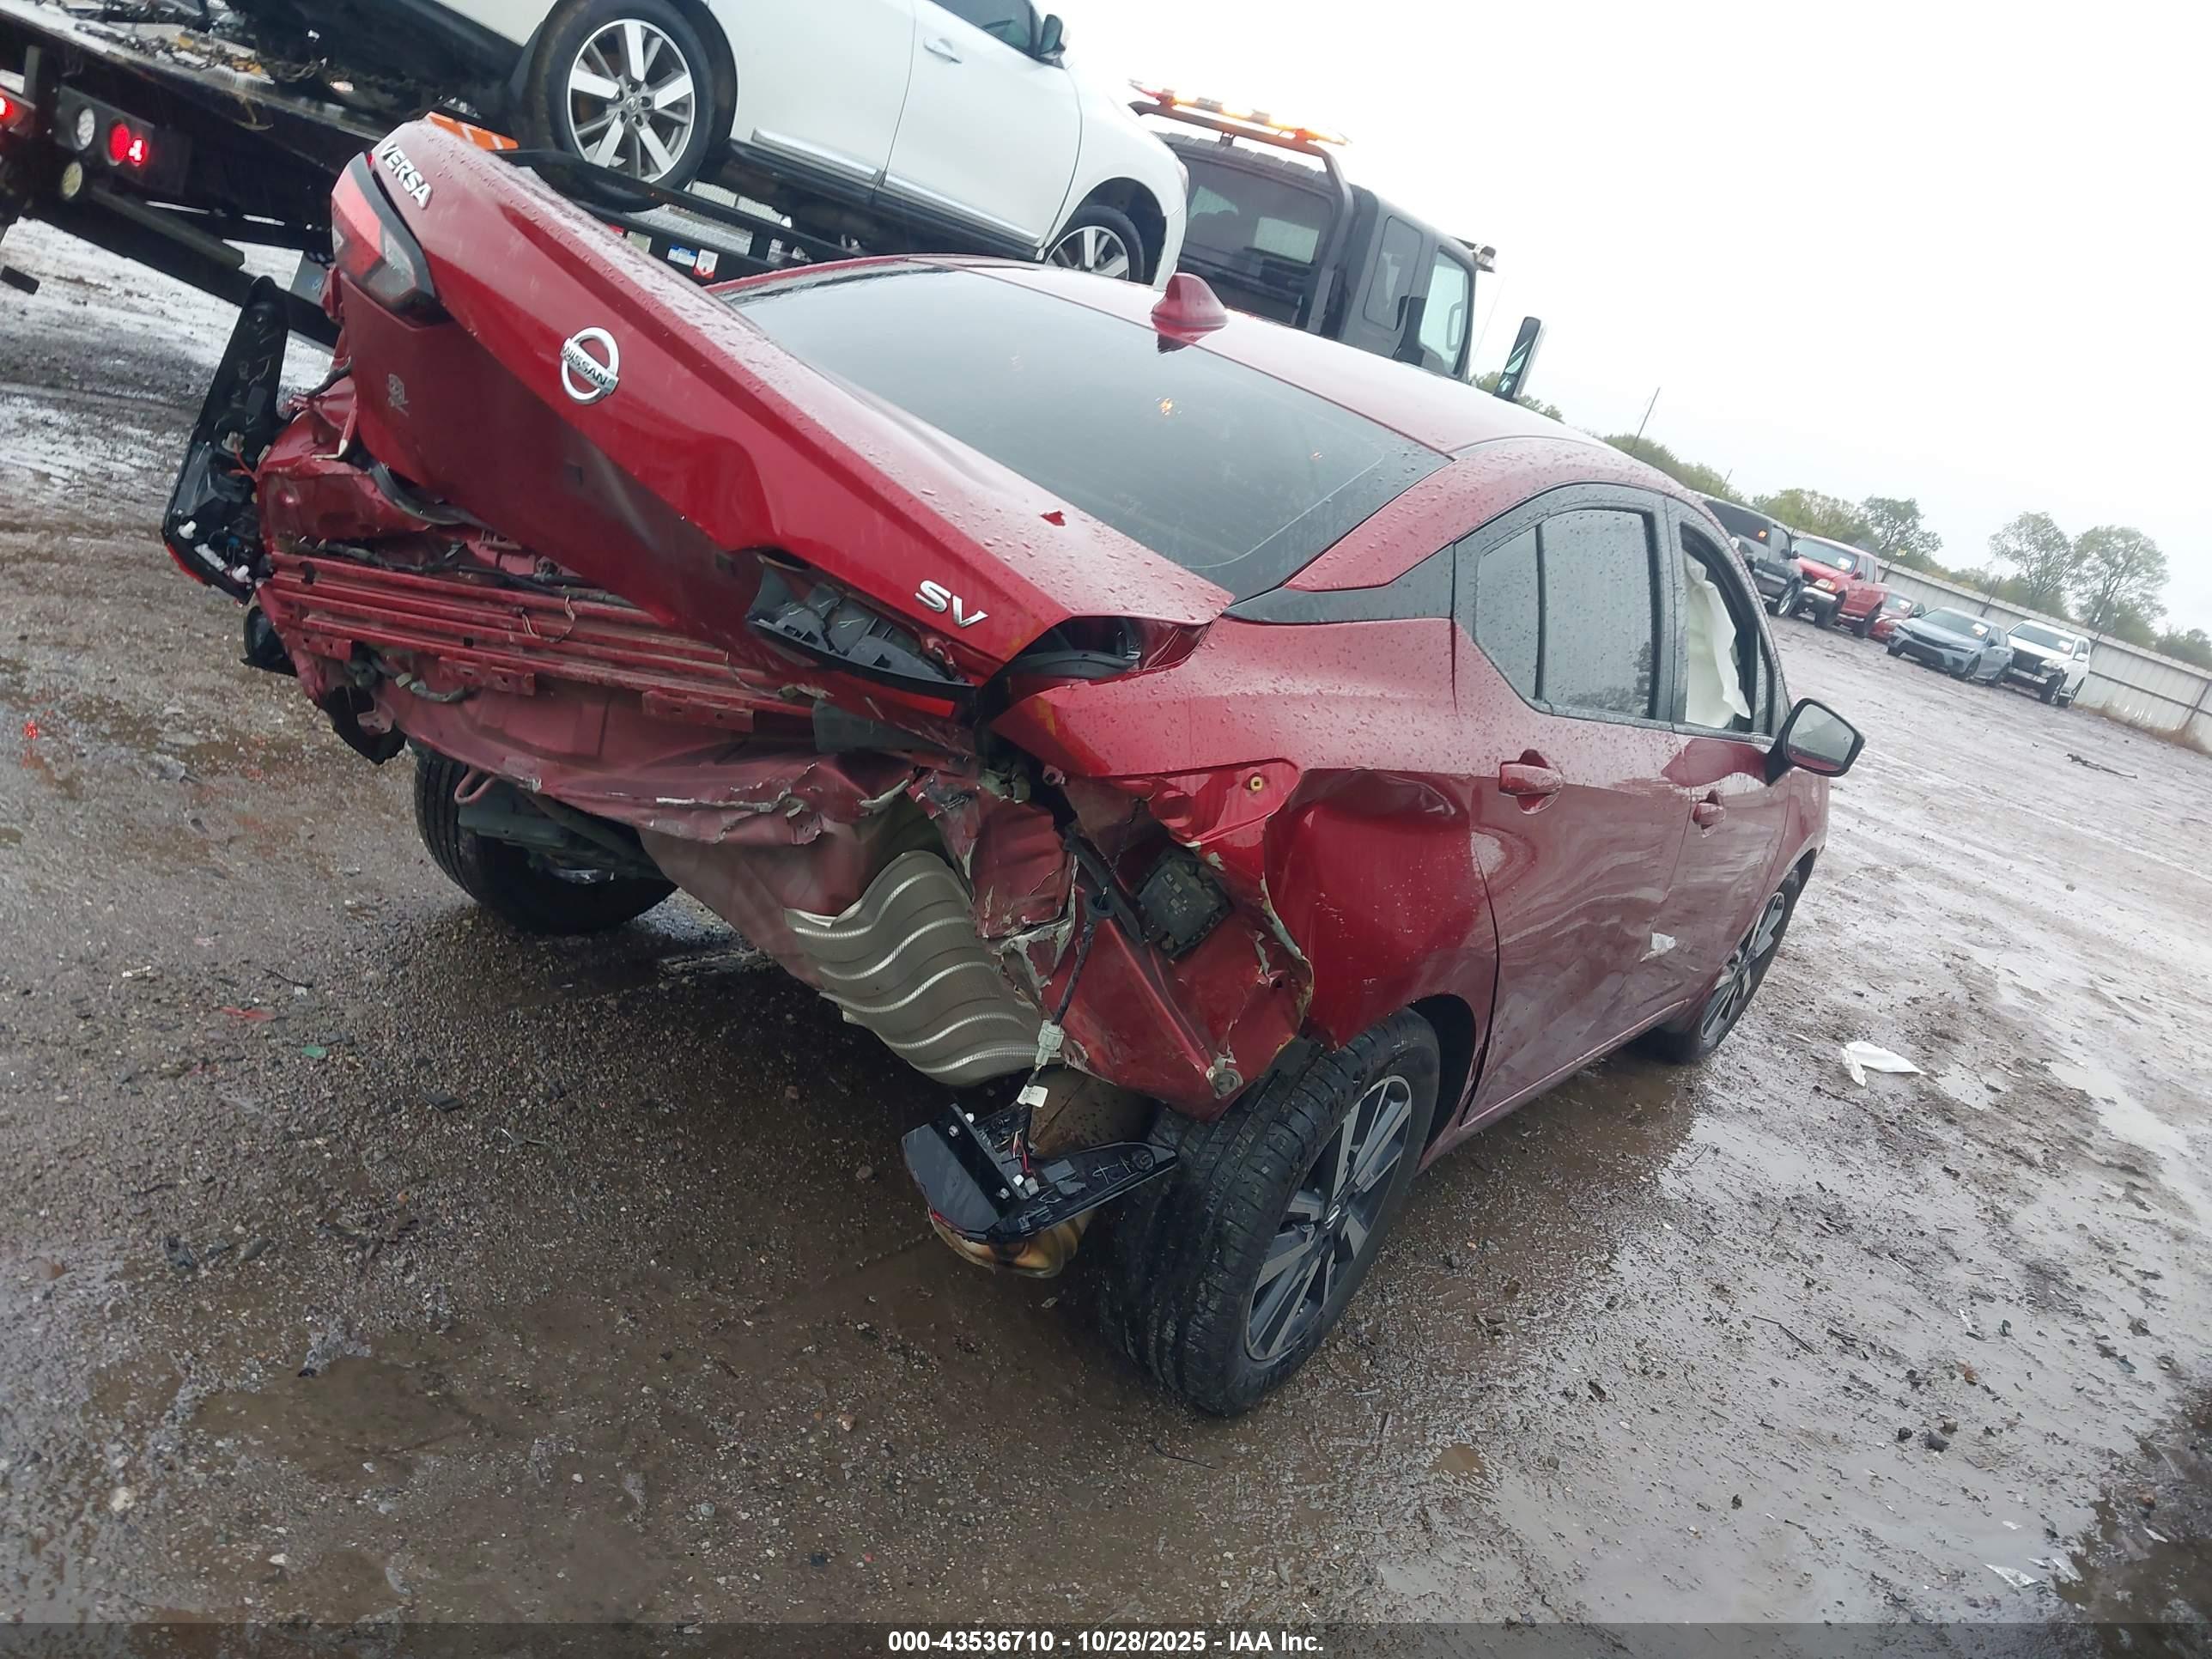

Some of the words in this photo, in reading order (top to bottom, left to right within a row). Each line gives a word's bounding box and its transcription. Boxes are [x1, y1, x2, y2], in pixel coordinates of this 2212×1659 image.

[380, 140, 432, 209] VERSA
[562, 345, 608, 386] NISSAN
[915, 580, 989, 628] SV
